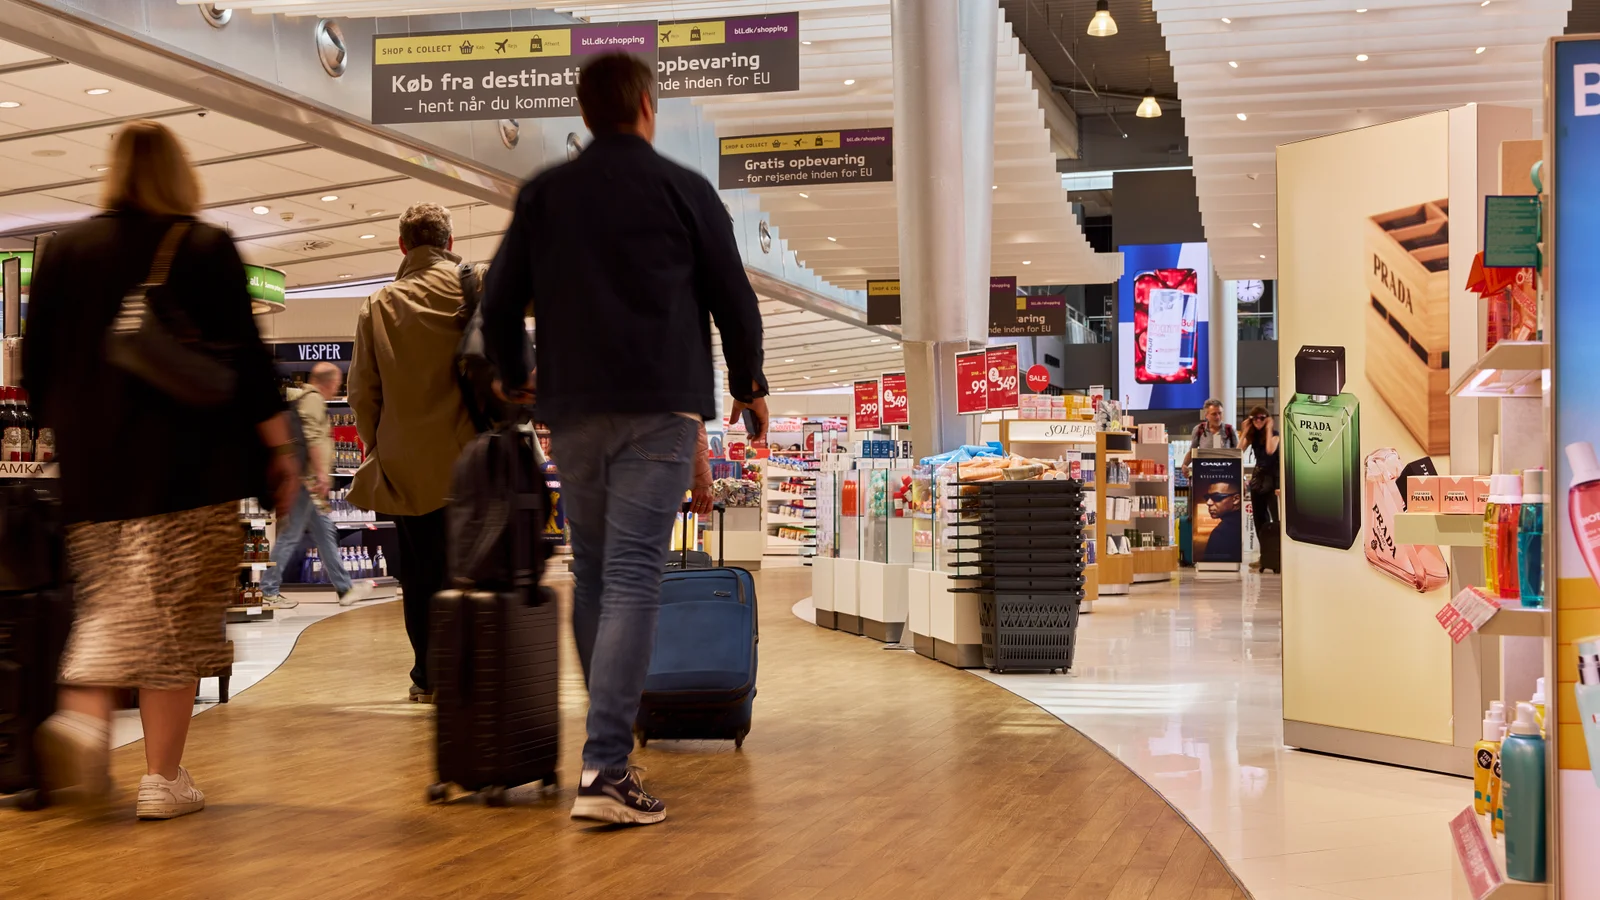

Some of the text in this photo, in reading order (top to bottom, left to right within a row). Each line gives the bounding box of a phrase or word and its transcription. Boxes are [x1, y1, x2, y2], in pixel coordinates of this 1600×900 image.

[734, 24, 788, 36] bll.dk/shopping
[581, 35, 645, 47] bll.dk/shopping
[382, 47, 404, 56] SHOP
[416, 44, 452, 54] COLLECT
[657, 53, 760, 75] opbevaring
[391, 74, 433, 93] Køb
[441, 73, 474, 91] fra
[684, 75, 722, 90] inden
[726, 74, 749, 87] for
[753, 72, 771, 85] EU
[418, 98, 454, 114] hent
[459, 95, 486, 112] når
[490, 97, 510, 111] du
[515, 94, 578, 110] kommer
[745, 141, 768, 149] COLLECT
[744, 154, 866, 171] Gratis opbevaring
[747, 174, 762, 182] for
[765, 171, 808, 184] rejsende
[811, 170, 839, 180] inden
[841, 168, 857, 178] for
[860, 167, 873, 177] EU
[1373, 253, 1414, 316] PRADA
[1003, 325, 1025, 334] inden
[1026, 325, 1040, 333] for
[1041, 324, 1052, 333] EU
[298, 343, 341, 360] VESPER
[1028, 374, 1048, 382] SALE
[860, 402, 878, 415] 299
[1045, 425, 1069, 437] SOL
[1300, 420, 1332, 432] PRADA
[1372, 504, 1397, 560] PRADA
